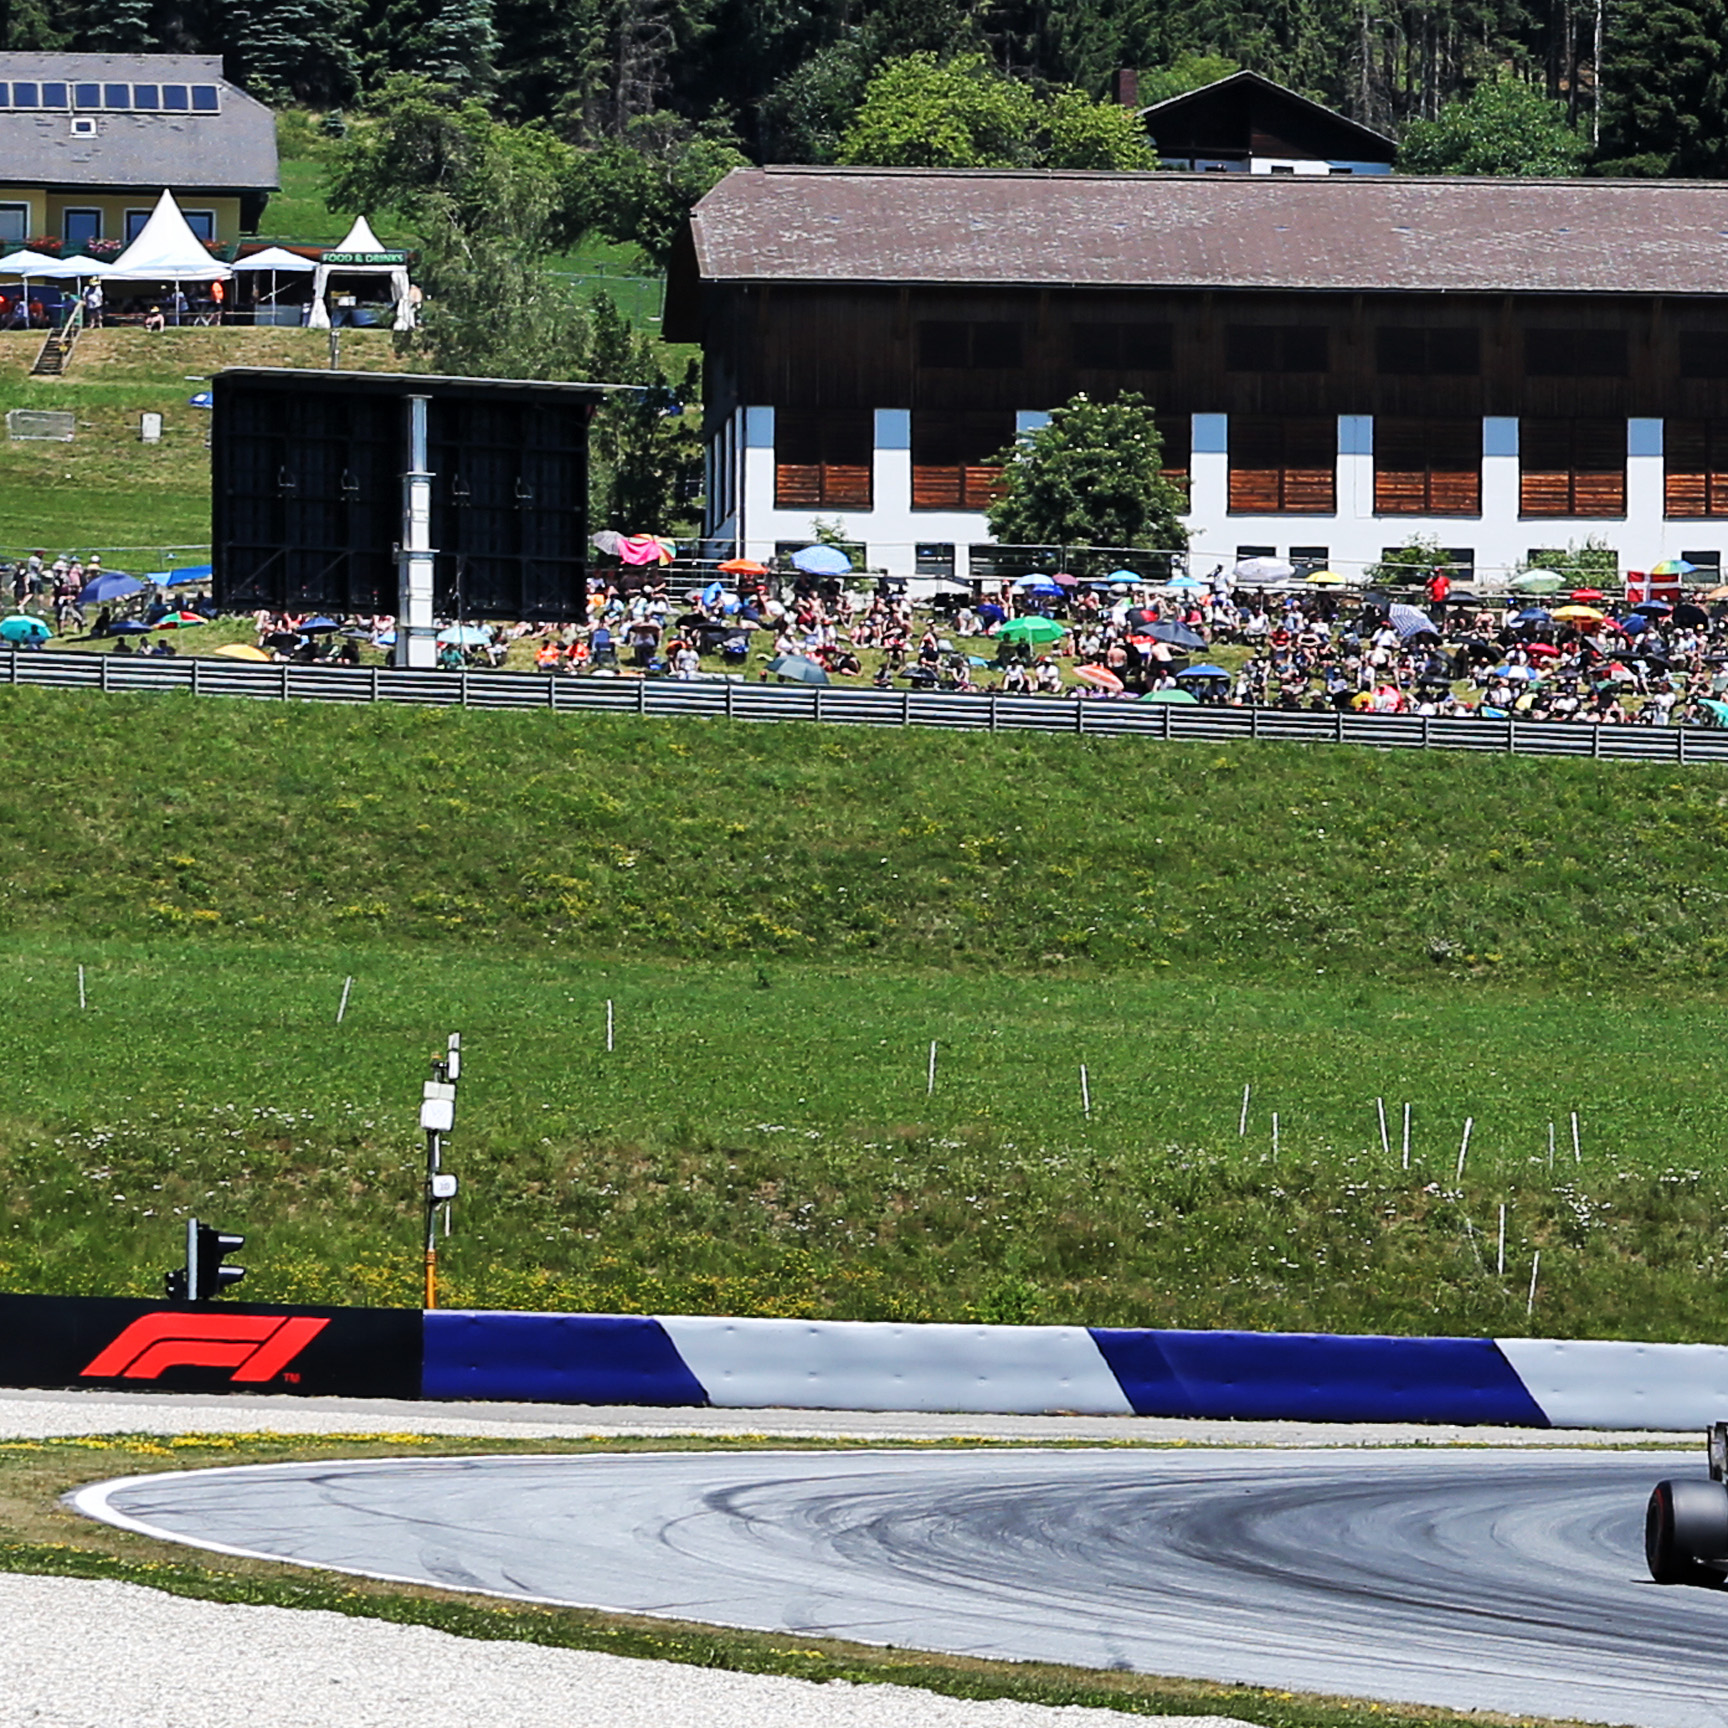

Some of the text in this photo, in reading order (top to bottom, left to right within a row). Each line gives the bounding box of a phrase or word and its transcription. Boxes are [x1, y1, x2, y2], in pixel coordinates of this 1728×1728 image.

[322, 253, 404, 263] FOOD & DRINKS
[79, 1311, 332, 1382] F1
[284, 1372, 301, 1384] TM
